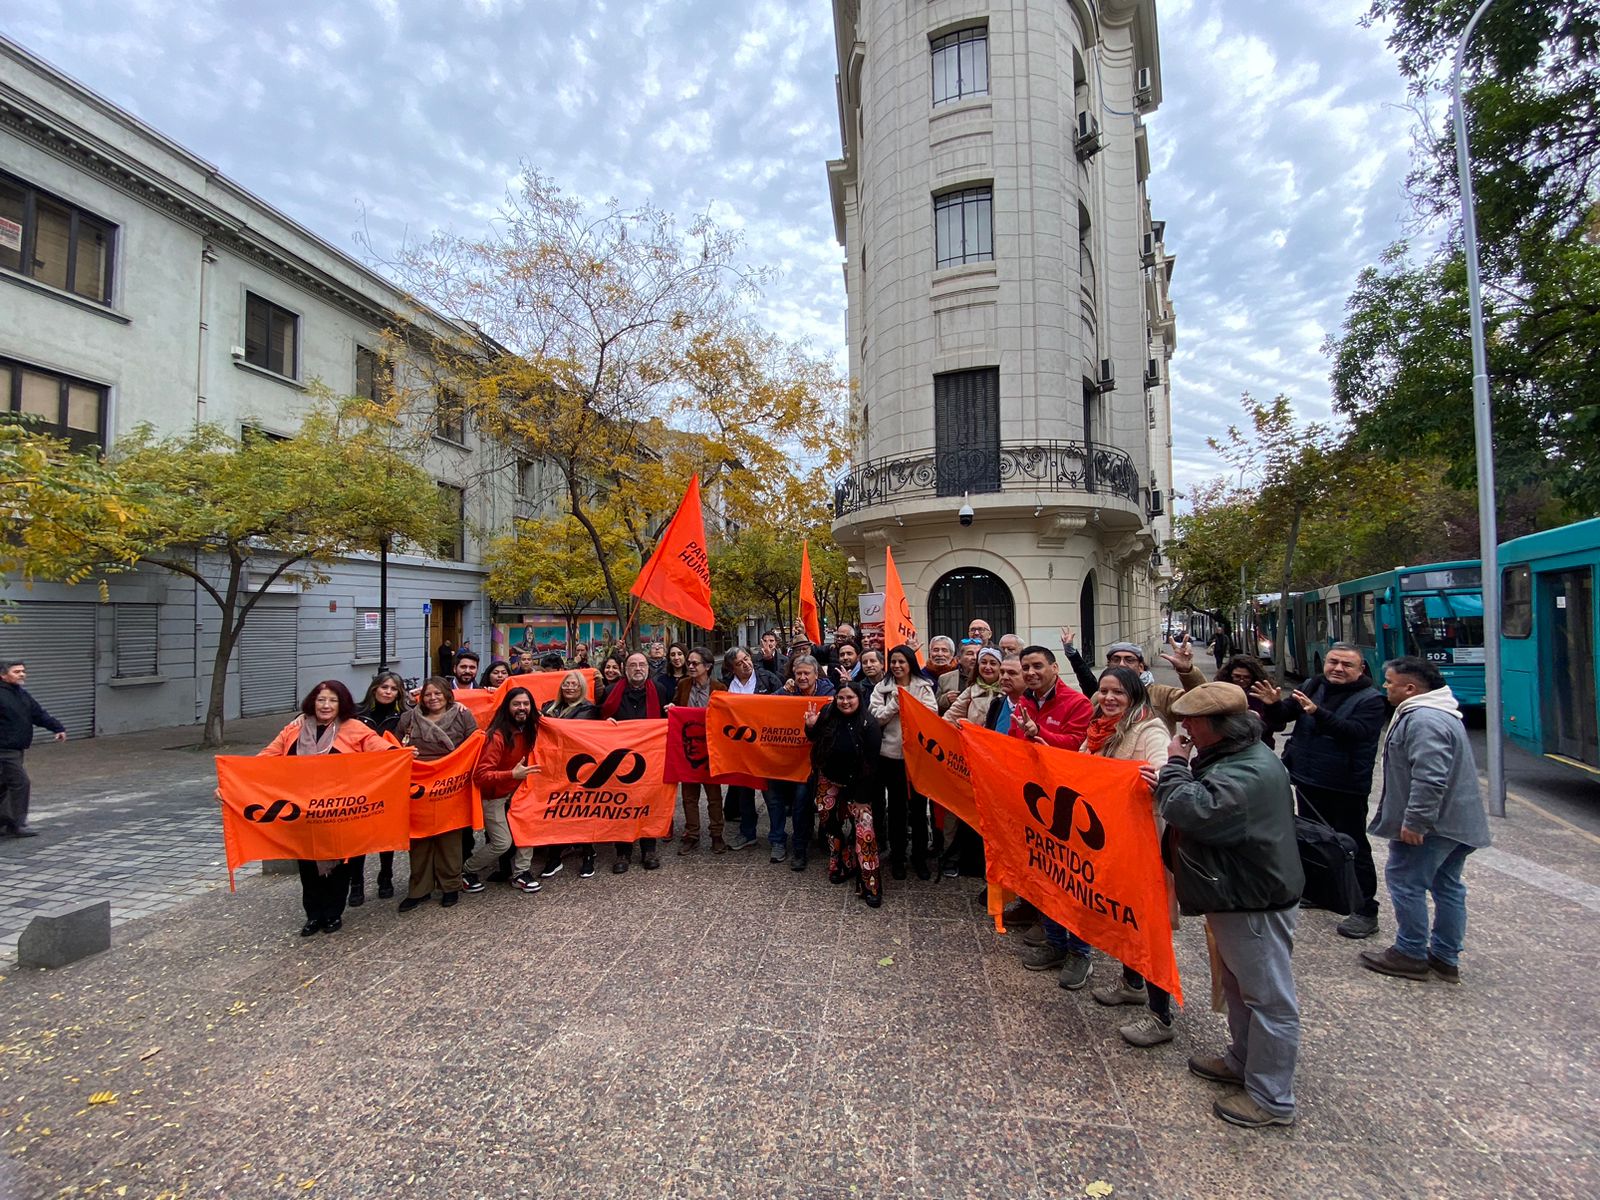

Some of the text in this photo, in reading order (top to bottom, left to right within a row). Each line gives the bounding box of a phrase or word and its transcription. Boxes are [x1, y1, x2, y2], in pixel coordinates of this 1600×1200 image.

[1427, 652, 1447, 661] 502
[761, 726, 801, 736] PARTIDO
[308, 795, 367, 809] PARTIDO
[547, 790, 628, 805] PARTIDO
[305, 800, 385, 819] HUMANISTA
[543, 804, 650, 820] HUMANISTA
[1025, 826, 1095, 884] PARTIDO
[1028, 848, 1139, 931] HUMANISTA
